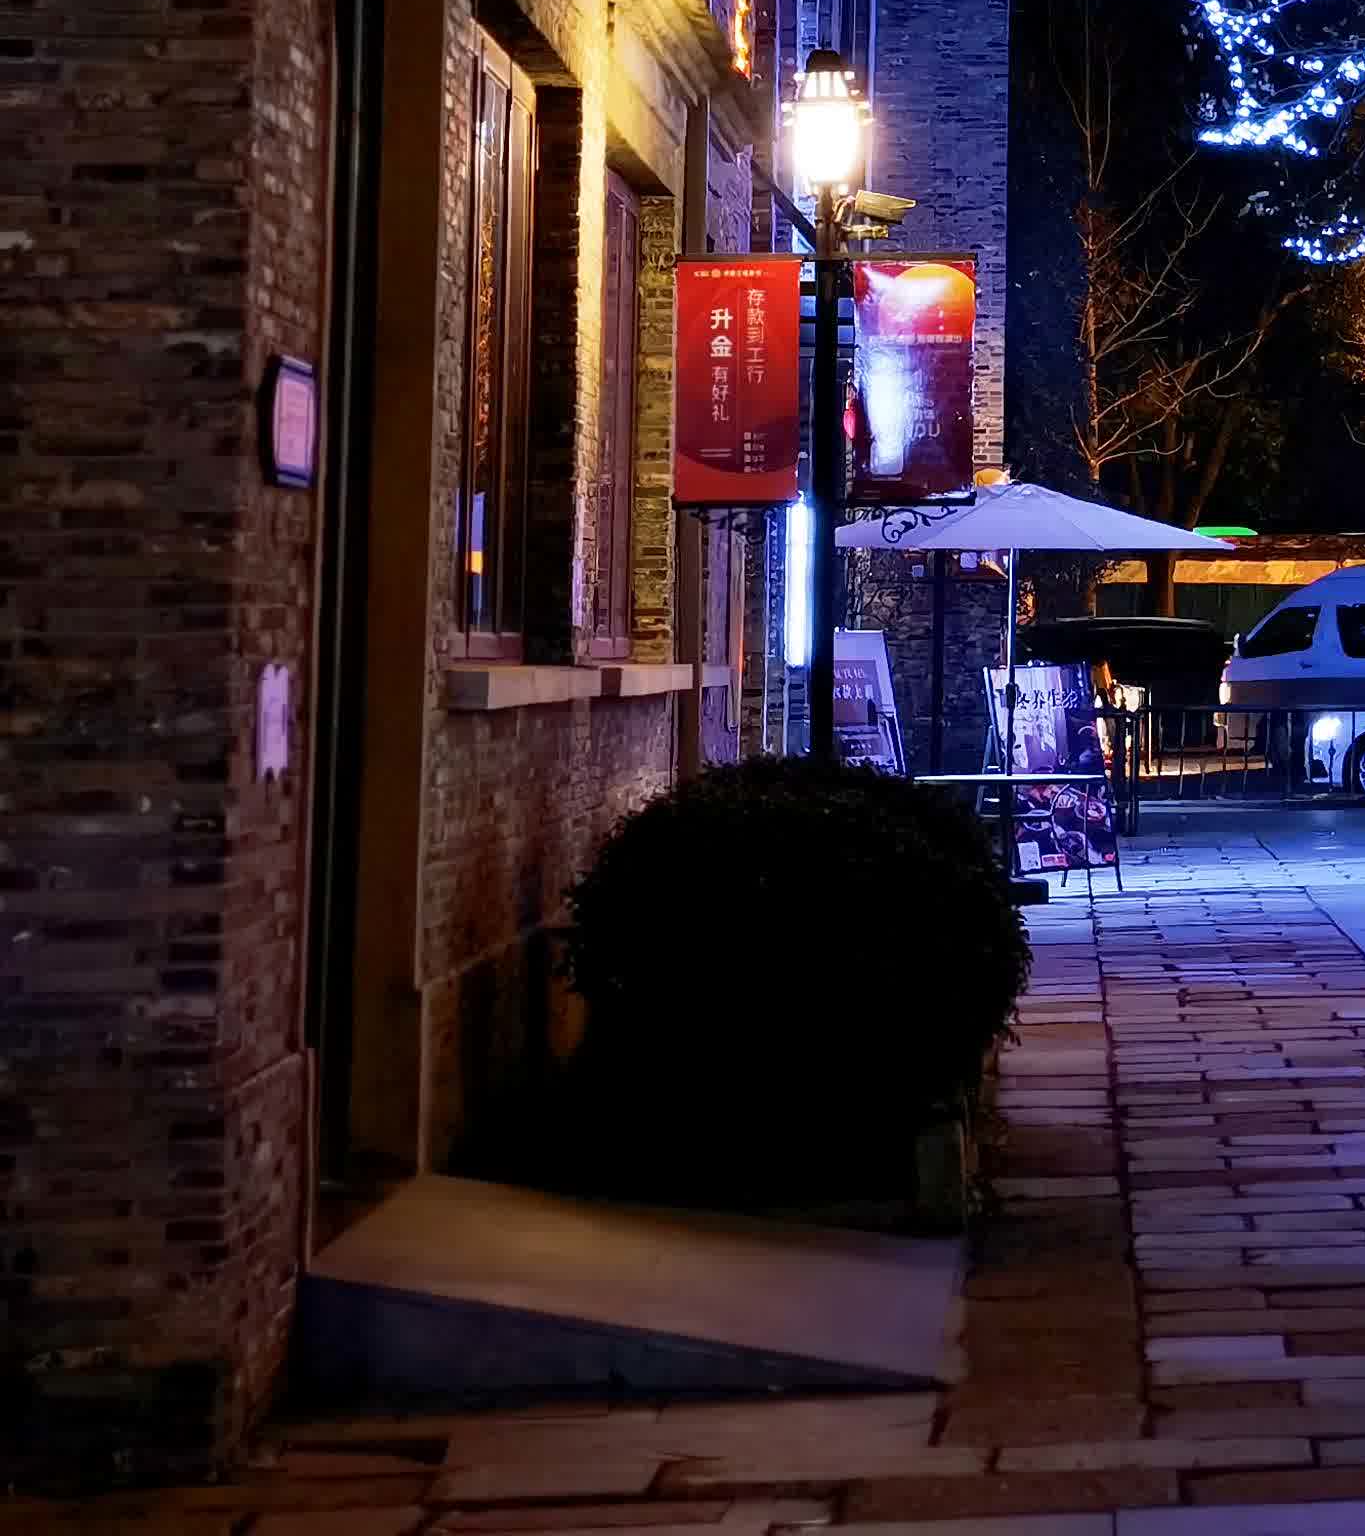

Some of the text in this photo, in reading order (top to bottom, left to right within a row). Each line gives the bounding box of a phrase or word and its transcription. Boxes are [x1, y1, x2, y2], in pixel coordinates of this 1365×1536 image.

[709, 307, 734, 422] 升金有好礼
[746, 288, 766, 385] 存款到工行
